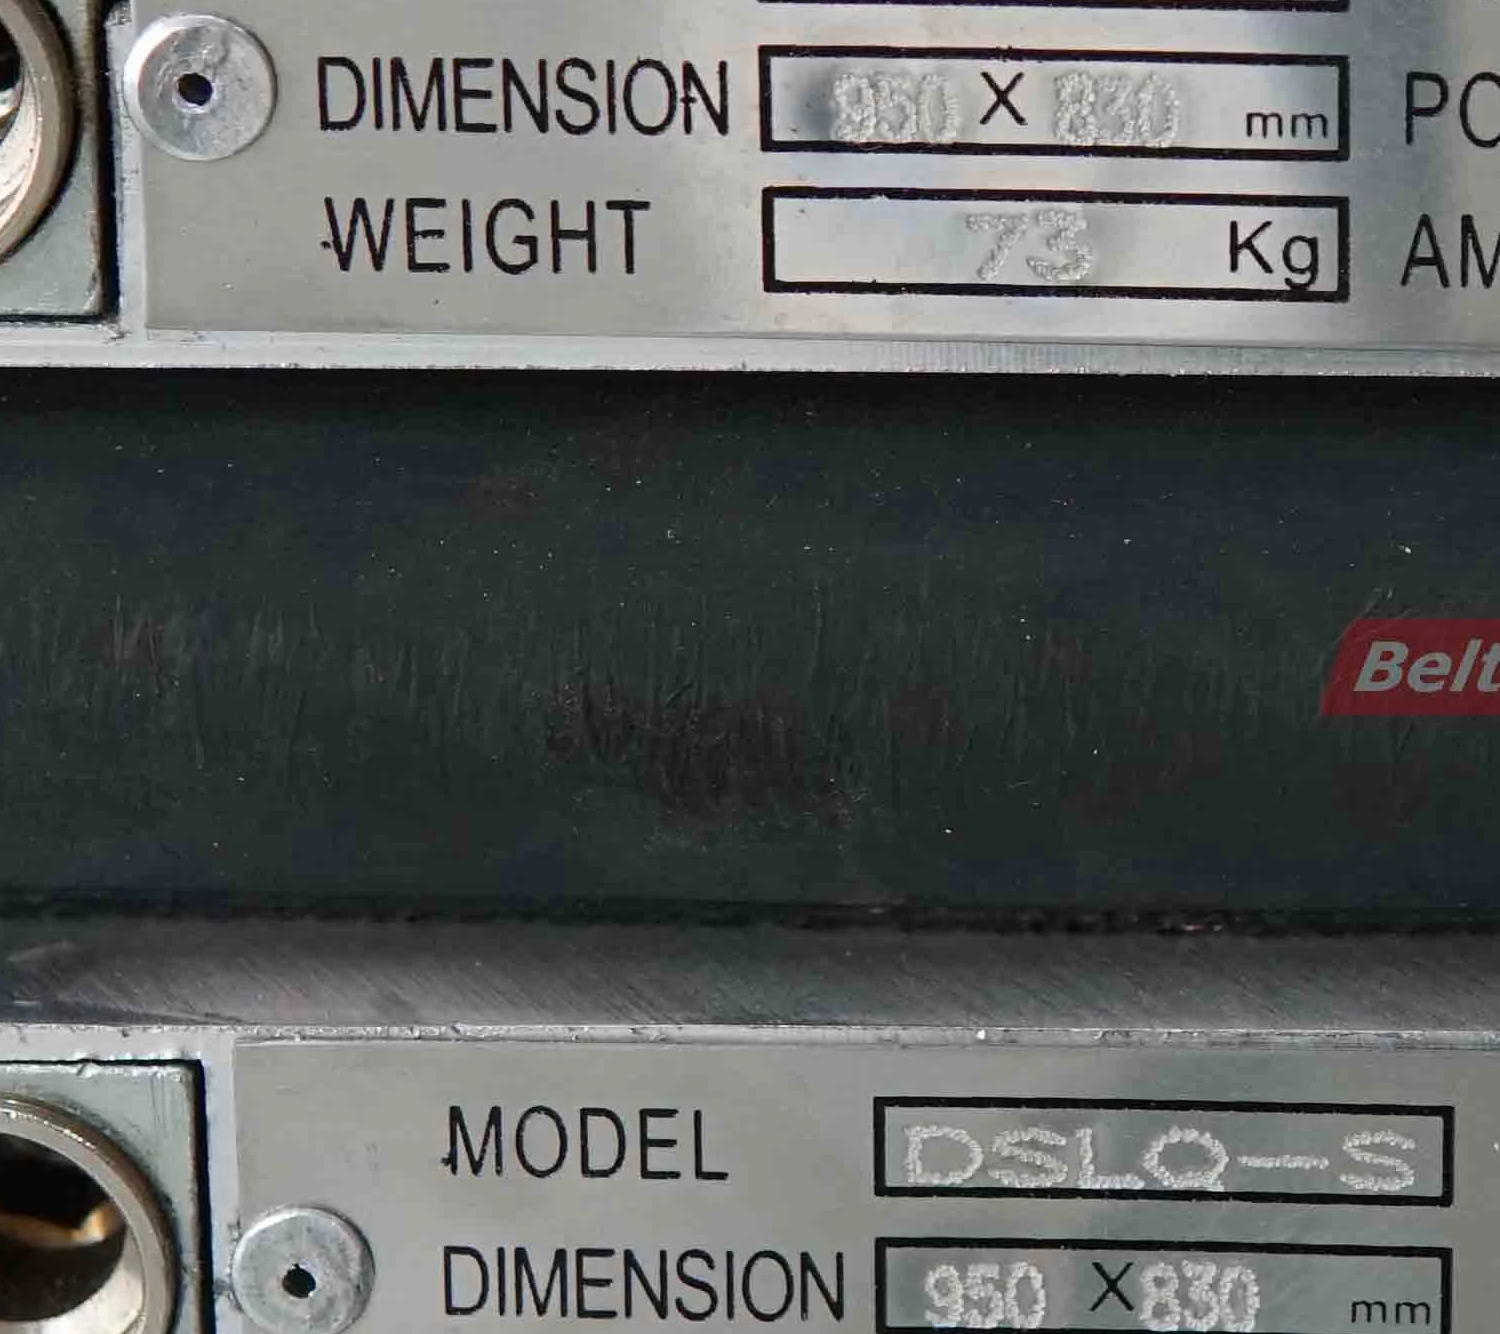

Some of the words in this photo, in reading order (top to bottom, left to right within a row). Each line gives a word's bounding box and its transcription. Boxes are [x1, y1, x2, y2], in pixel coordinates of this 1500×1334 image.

[317, 56, 730, 136] DIMENSION
[1245, 109, 1329, 139] mm
[322, 198, 652, 275] WEIGHT
[964, 210, 1093, 284] 73
[1228, 221, 1320, 291] Kg
[445, 1104, 730, 1183] MODEL
[442, 1245, 847, 1323] DIMENSION
[924, 1262, 1047, 1331] 950
[1137, 1260, 1263, 1334] 830
[1349, 1298, 1432, 1325] mm
